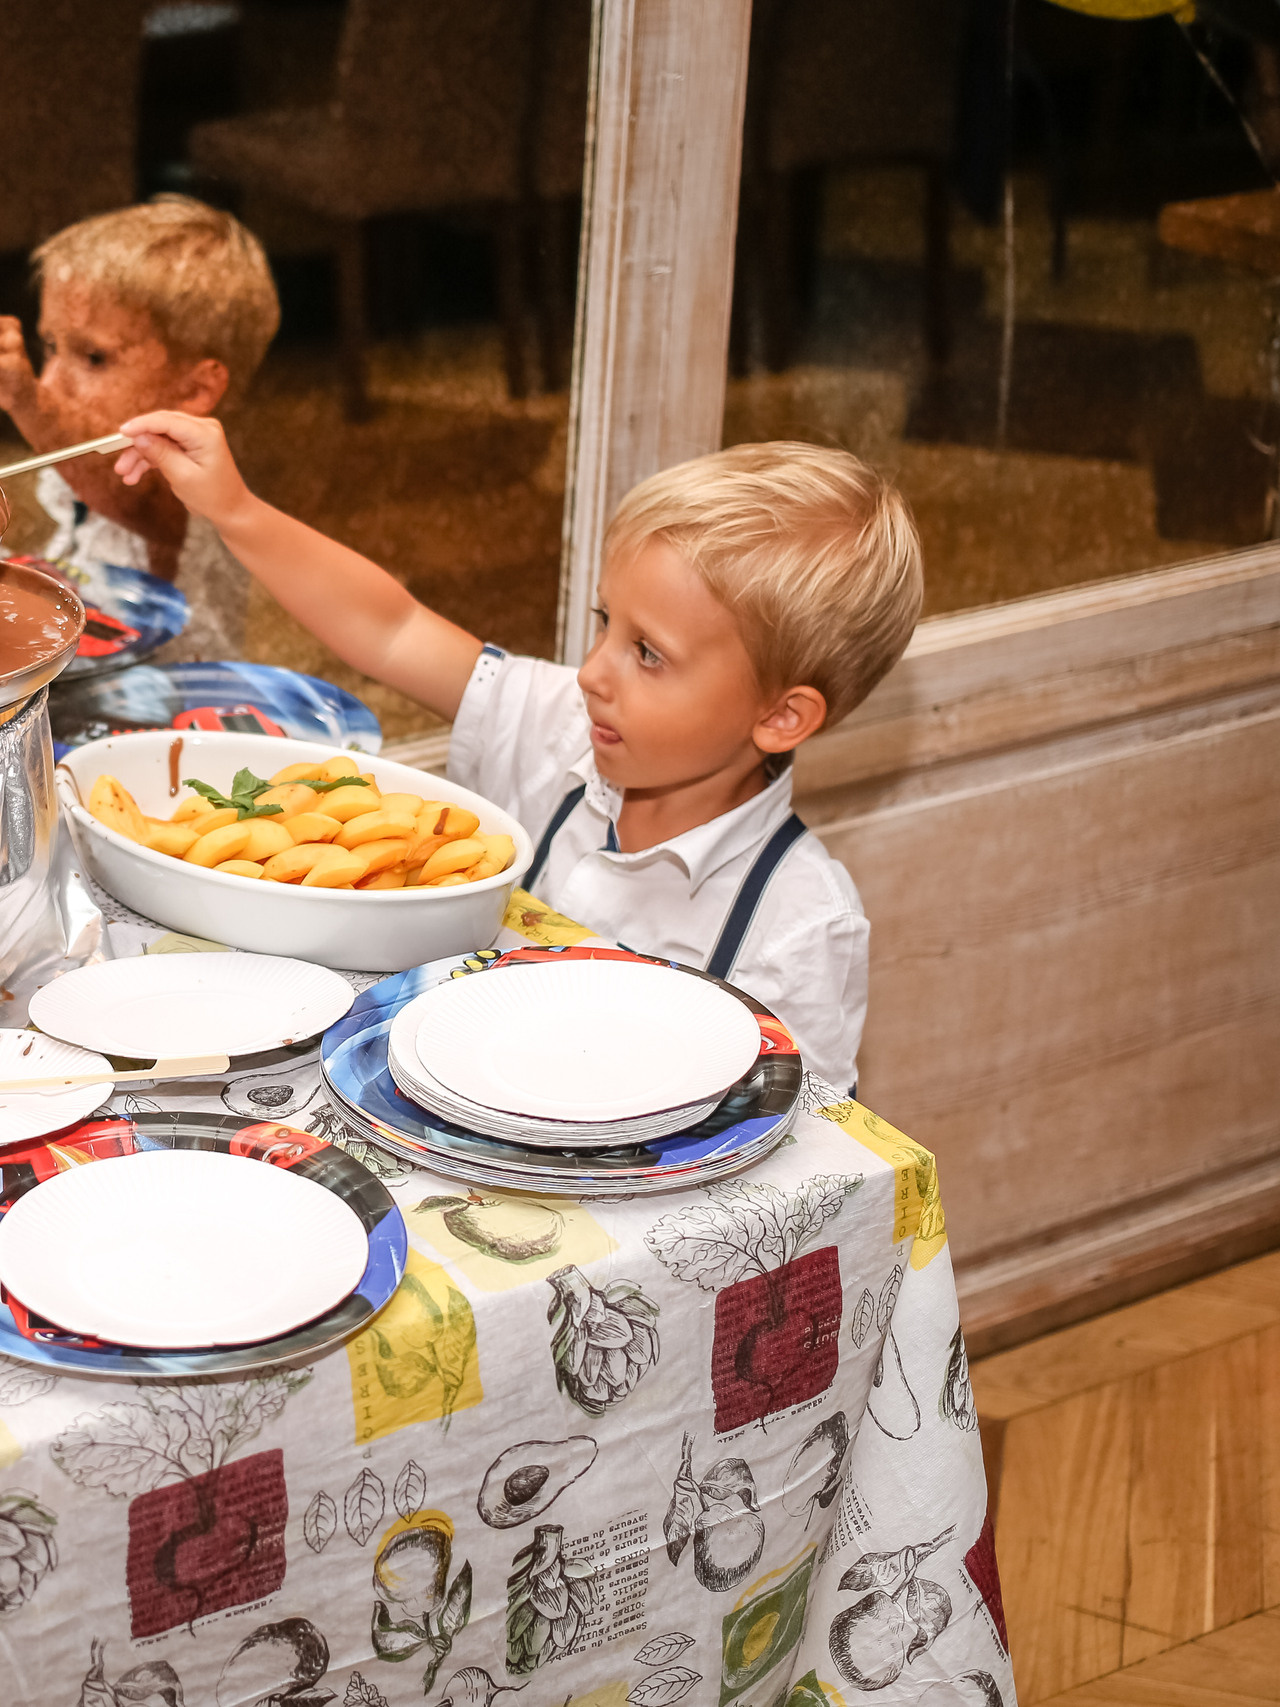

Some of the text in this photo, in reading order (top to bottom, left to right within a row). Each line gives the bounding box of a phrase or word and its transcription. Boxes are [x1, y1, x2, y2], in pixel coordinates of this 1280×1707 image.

[593, 1529, 604, 1538] du
[600, 1548, 610, 1557] de
[615, 1556, 649, 1573] pommes
[609, 1568, 648, 1588] Saveurs
[600, 1603, 610, 1611] de
[607, 1622, 647, 1642] Saveurs
[591, 1640, 603, 1648] du
